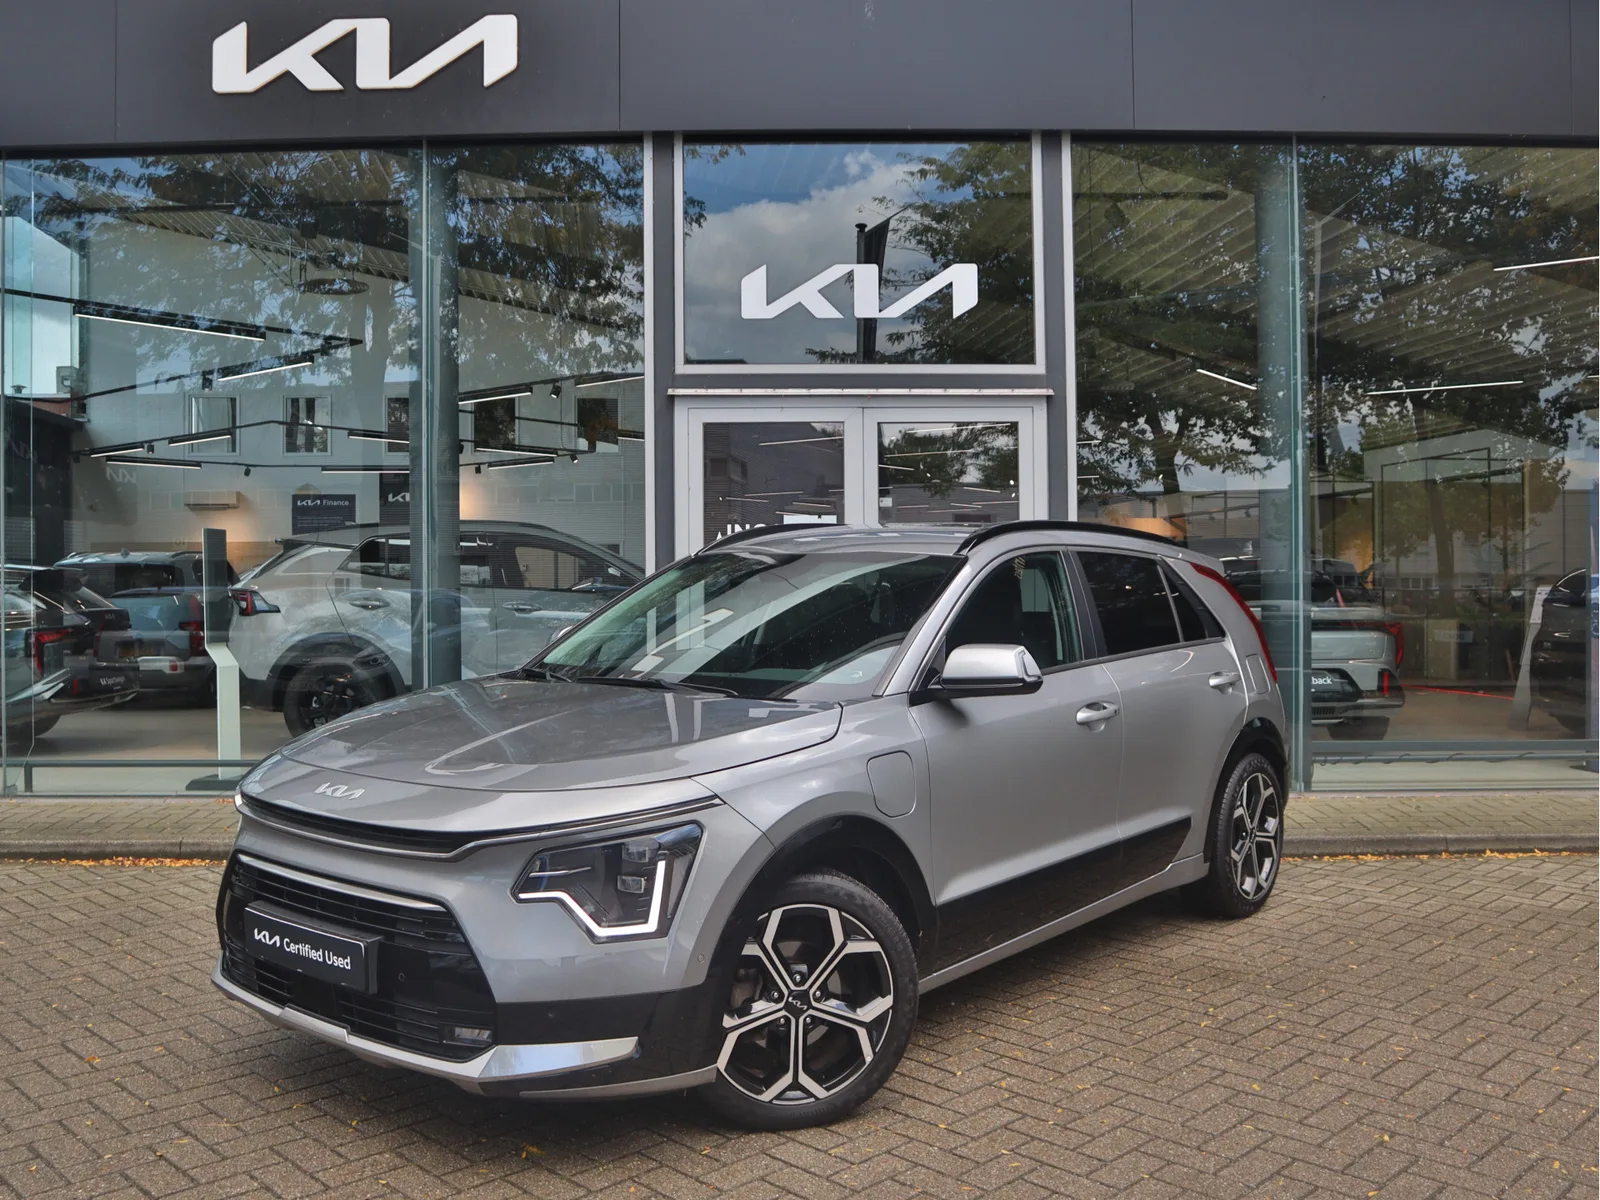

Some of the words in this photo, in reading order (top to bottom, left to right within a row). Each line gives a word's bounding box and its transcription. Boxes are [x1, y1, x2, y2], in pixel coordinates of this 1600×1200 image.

[212, 14, 518, 93] KIA
[741, 263, 978, 319] KIA
[1311, 676, 1333, 685] back
[314, 782, 365, 800] KIA
[254, 928, 280, 948] KIA
[283, 938, 323, 962] Certified
[325, 950, 351, 970] Used
